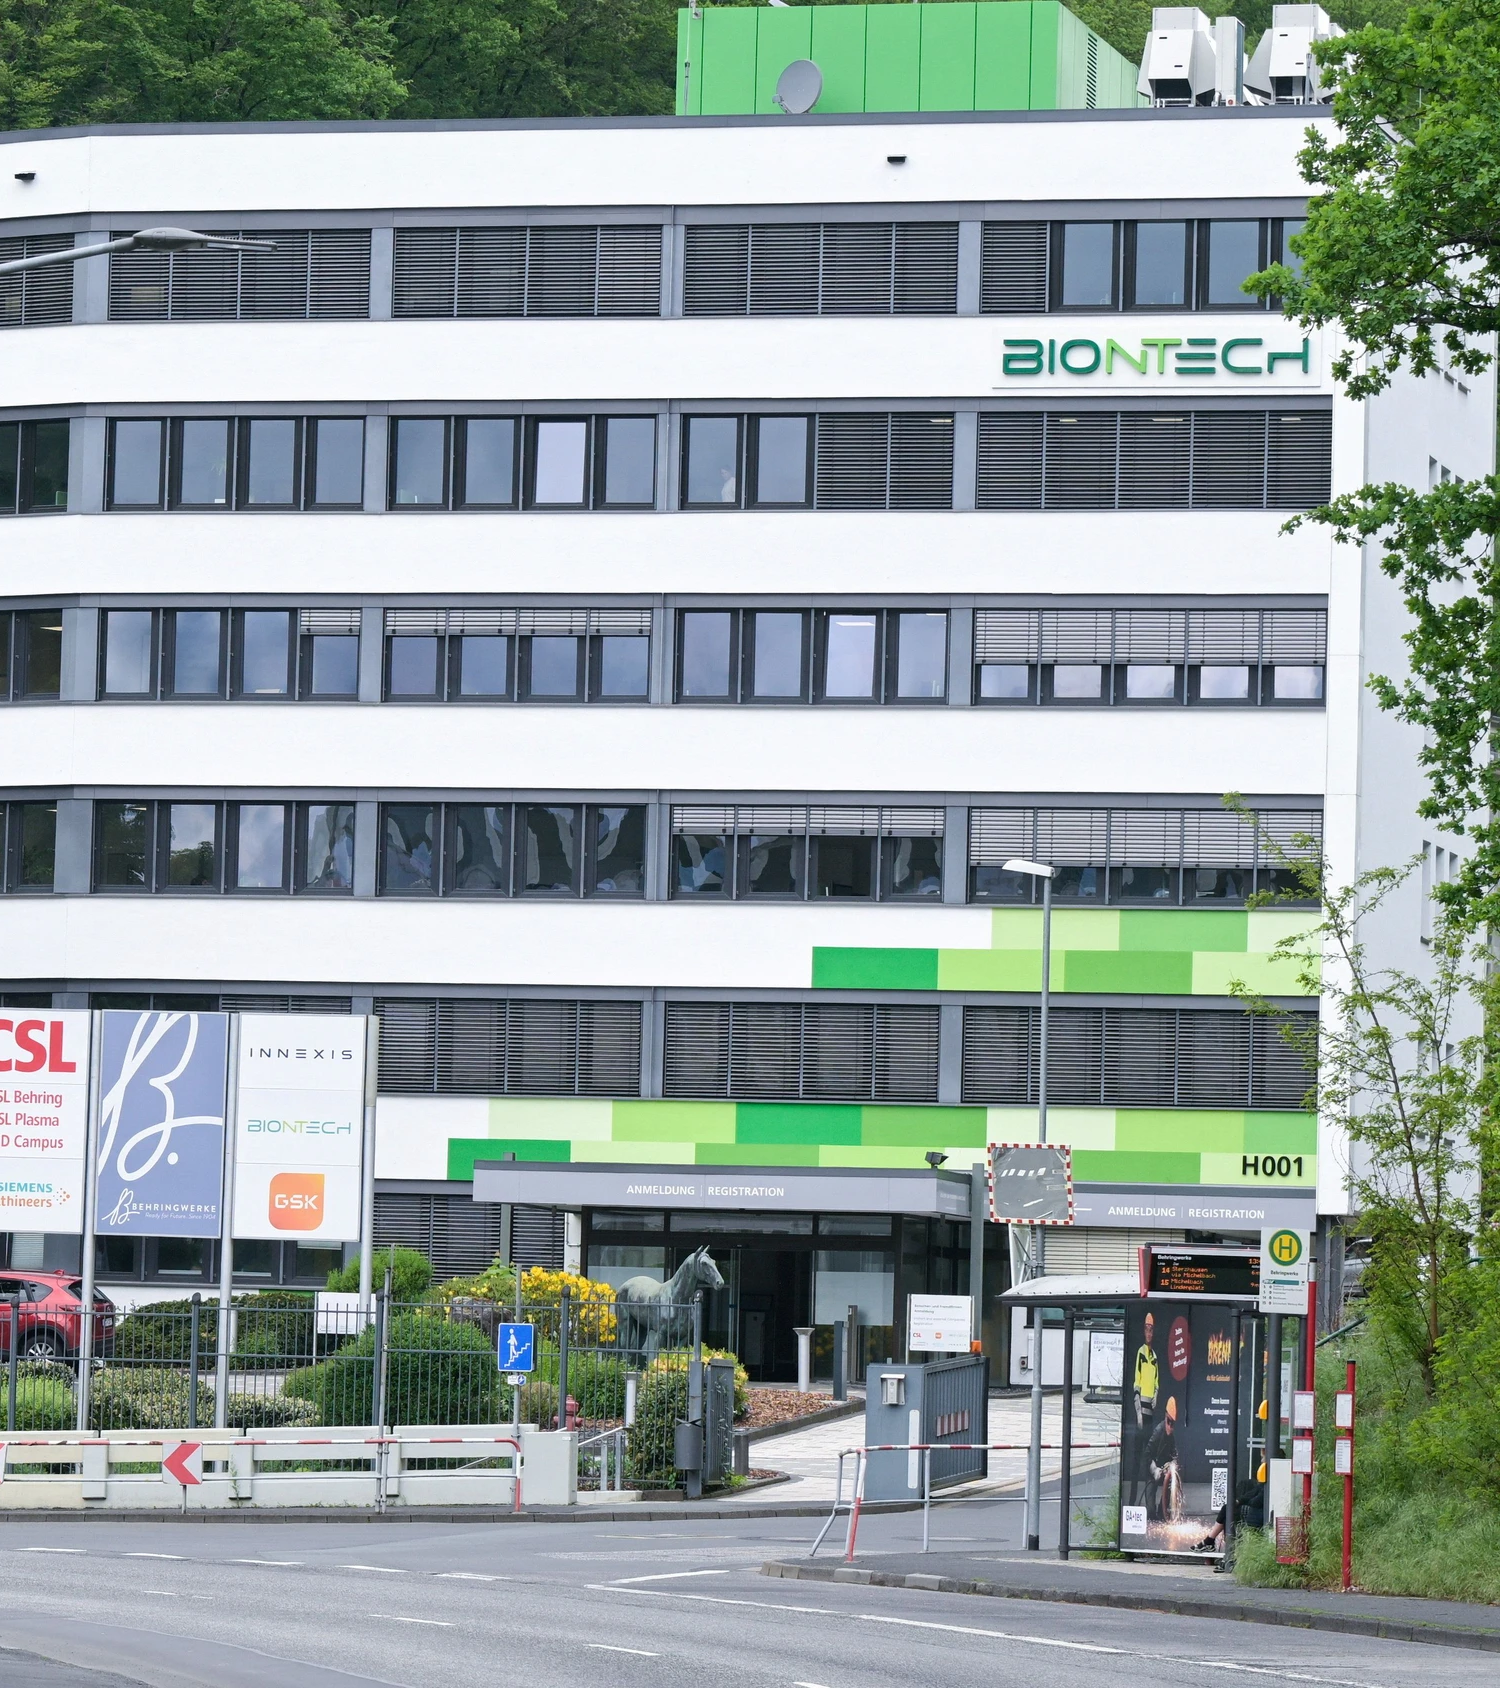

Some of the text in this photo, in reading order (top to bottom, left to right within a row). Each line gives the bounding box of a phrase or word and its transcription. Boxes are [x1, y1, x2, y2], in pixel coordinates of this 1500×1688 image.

[1002, 338, 1309, 375] BIONTECH
[249, 1047, 353, 1060] INNEXIS
[13, 1089, 63, 1108] Behring
[14, 1112, 60, 1127] Plasma
[247, 1119, 352, 1135] BIONTECH
[13, 1134, 64, 1152] Campus
[1241, 1155, 1304, 1177] H001
[626, 1185, 785, 1197] ANMELDUNG REGISTRATION
[131, 1203, 217, 1213] BEHRINGWERKE
[274, 1193, 319, 1210] GSK
[1108, 1206, 1265, 1219] ANMELDUNG REGISTRATION
[1157, 1254, 1193, 1262] Behringwerke
